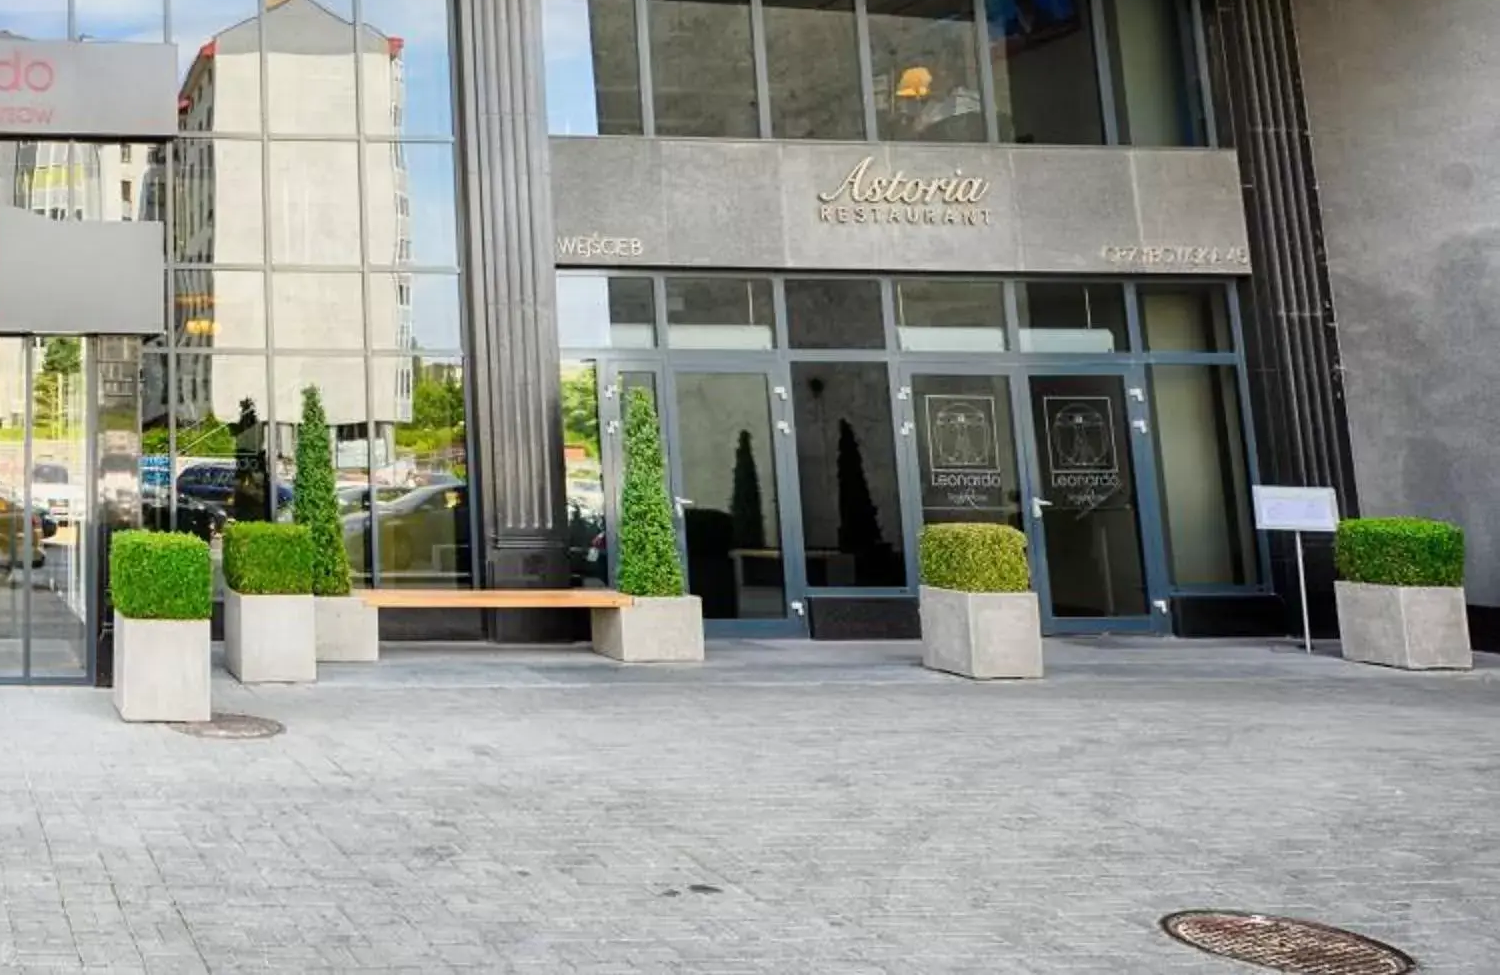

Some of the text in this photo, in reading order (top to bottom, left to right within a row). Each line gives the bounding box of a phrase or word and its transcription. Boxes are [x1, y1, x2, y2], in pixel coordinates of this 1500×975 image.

[818, 156, 988, 203] Astoria
[819, 206, 992, 226] RESTAURANT
[931, 472, 1001, 487] Leonardo
